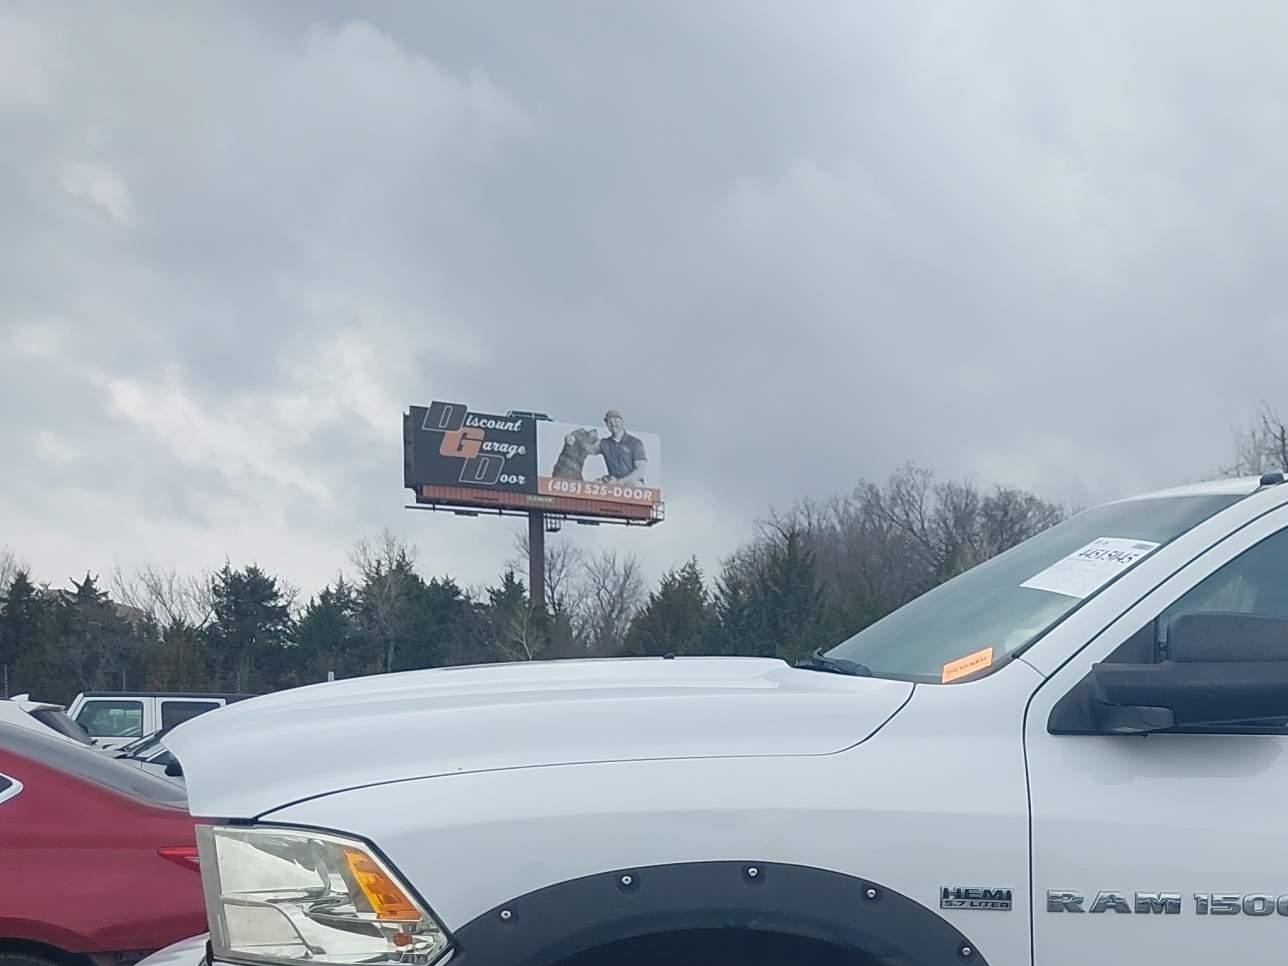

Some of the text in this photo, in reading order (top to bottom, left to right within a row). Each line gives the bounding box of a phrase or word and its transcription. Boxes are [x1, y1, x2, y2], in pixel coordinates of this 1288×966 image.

[422, 400, 522, 432] Discount
[439, 427, 527, 459] Garage
[459, 453, 526, 485] Door
[548, 480, 652, 500] (405) 525-DOOR
[942, 887, 1012, 901] HEMI
[969, 901, 1009, 909] LITER
[1046, 889, 1182, 915] RAM
